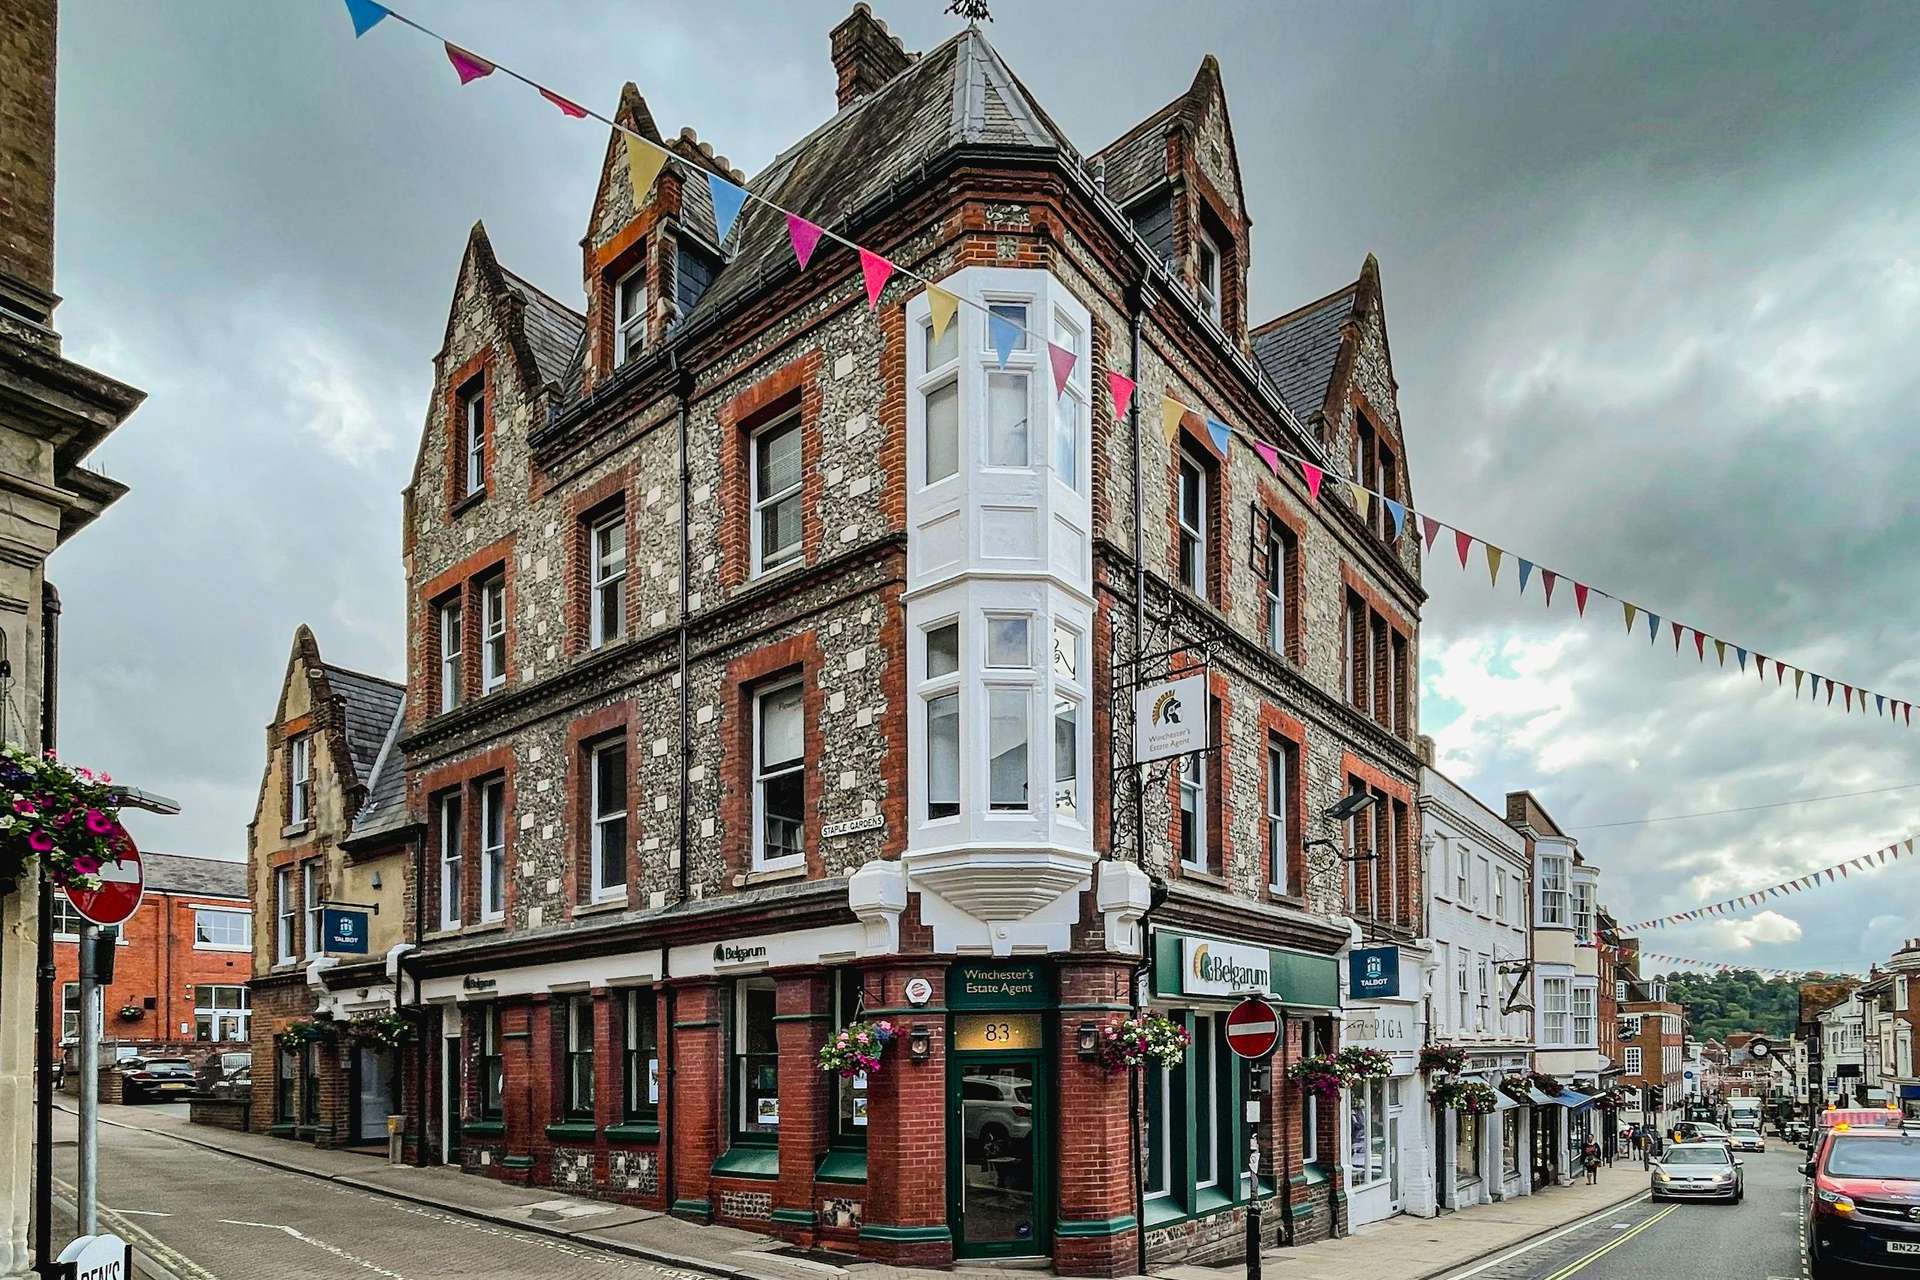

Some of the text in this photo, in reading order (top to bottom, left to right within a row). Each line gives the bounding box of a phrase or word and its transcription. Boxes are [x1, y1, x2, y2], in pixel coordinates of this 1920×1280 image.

[1149, 728, 1190, 742] Winchester's
[1149, 738, 1190, 752] Estate Agent
[823, 817, 882, 836] STAPLE GARDENS
[725, 945, 767, 962] Belgarum
[964, 969, 1034, 980] Winchester's
[1214, 955, 1268, 991] Belgarum
[966, 982, 1033, 996] Estate Agent
[1360, 978, 1388, 987] TALBOT
[986, 1023, 1010, 1042] 83
[1892, 1242, 1920, 1253] BN22
